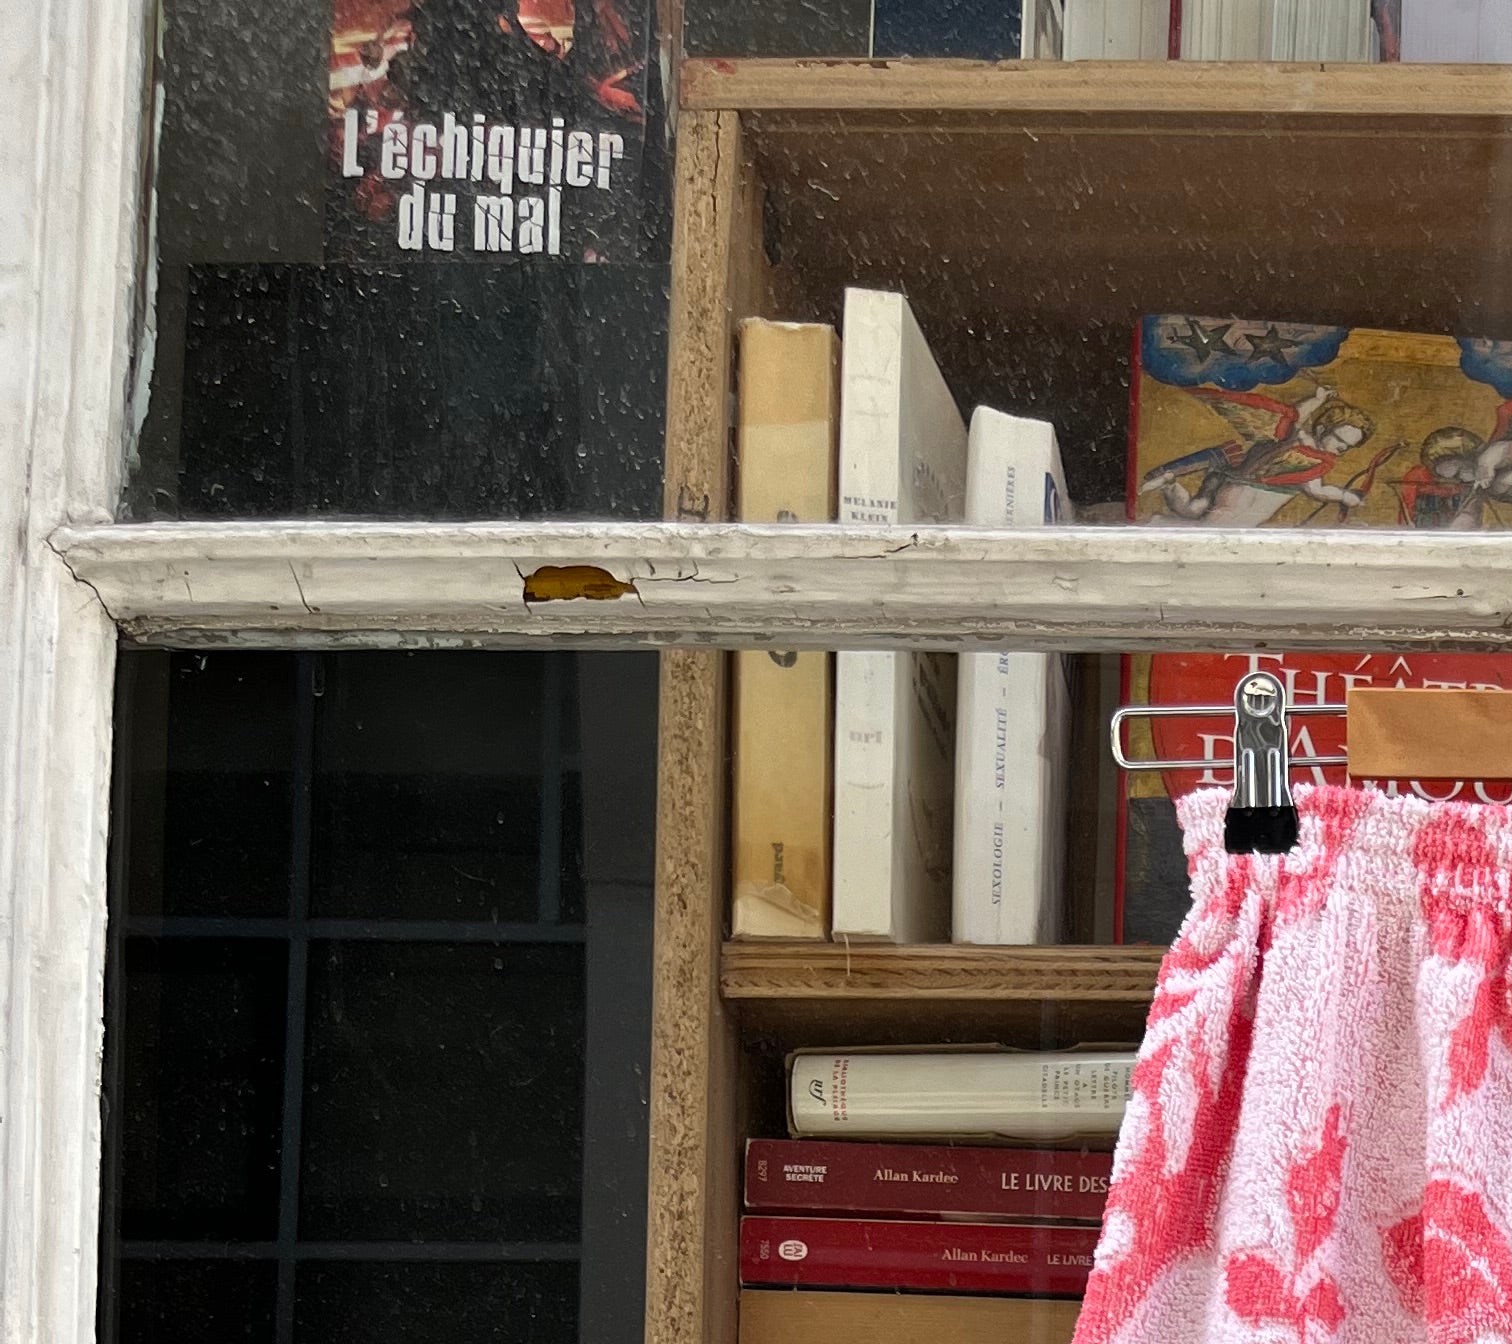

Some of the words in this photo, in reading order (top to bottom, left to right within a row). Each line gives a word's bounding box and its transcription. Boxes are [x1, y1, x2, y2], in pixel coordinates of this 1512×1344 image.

[342, 109, 625, 191] L'échiquier
[397, 184, 455, 252] du
[473, 186, 562, 256] mal
[808, 1078, 827, 1106] nrf
[783, 1164, 827, 1175] AVENTURE
[873, 1169, 908, 1183] Allan
[912, 1169, 959, 1184] Kardec
[1001, 1173, 1020, 1191] LE
[1025, 1173, 1073, 1193] LIVRE
[1079, 1176, 1108, 1194] DES
[941, 1249, 977, 1262] Allan
[981, 1250, 1028, 1264] Kardec
[1047, 1254, 1060, 1266] LE
[1062, 1254, 1093, 1266] LIVRE
